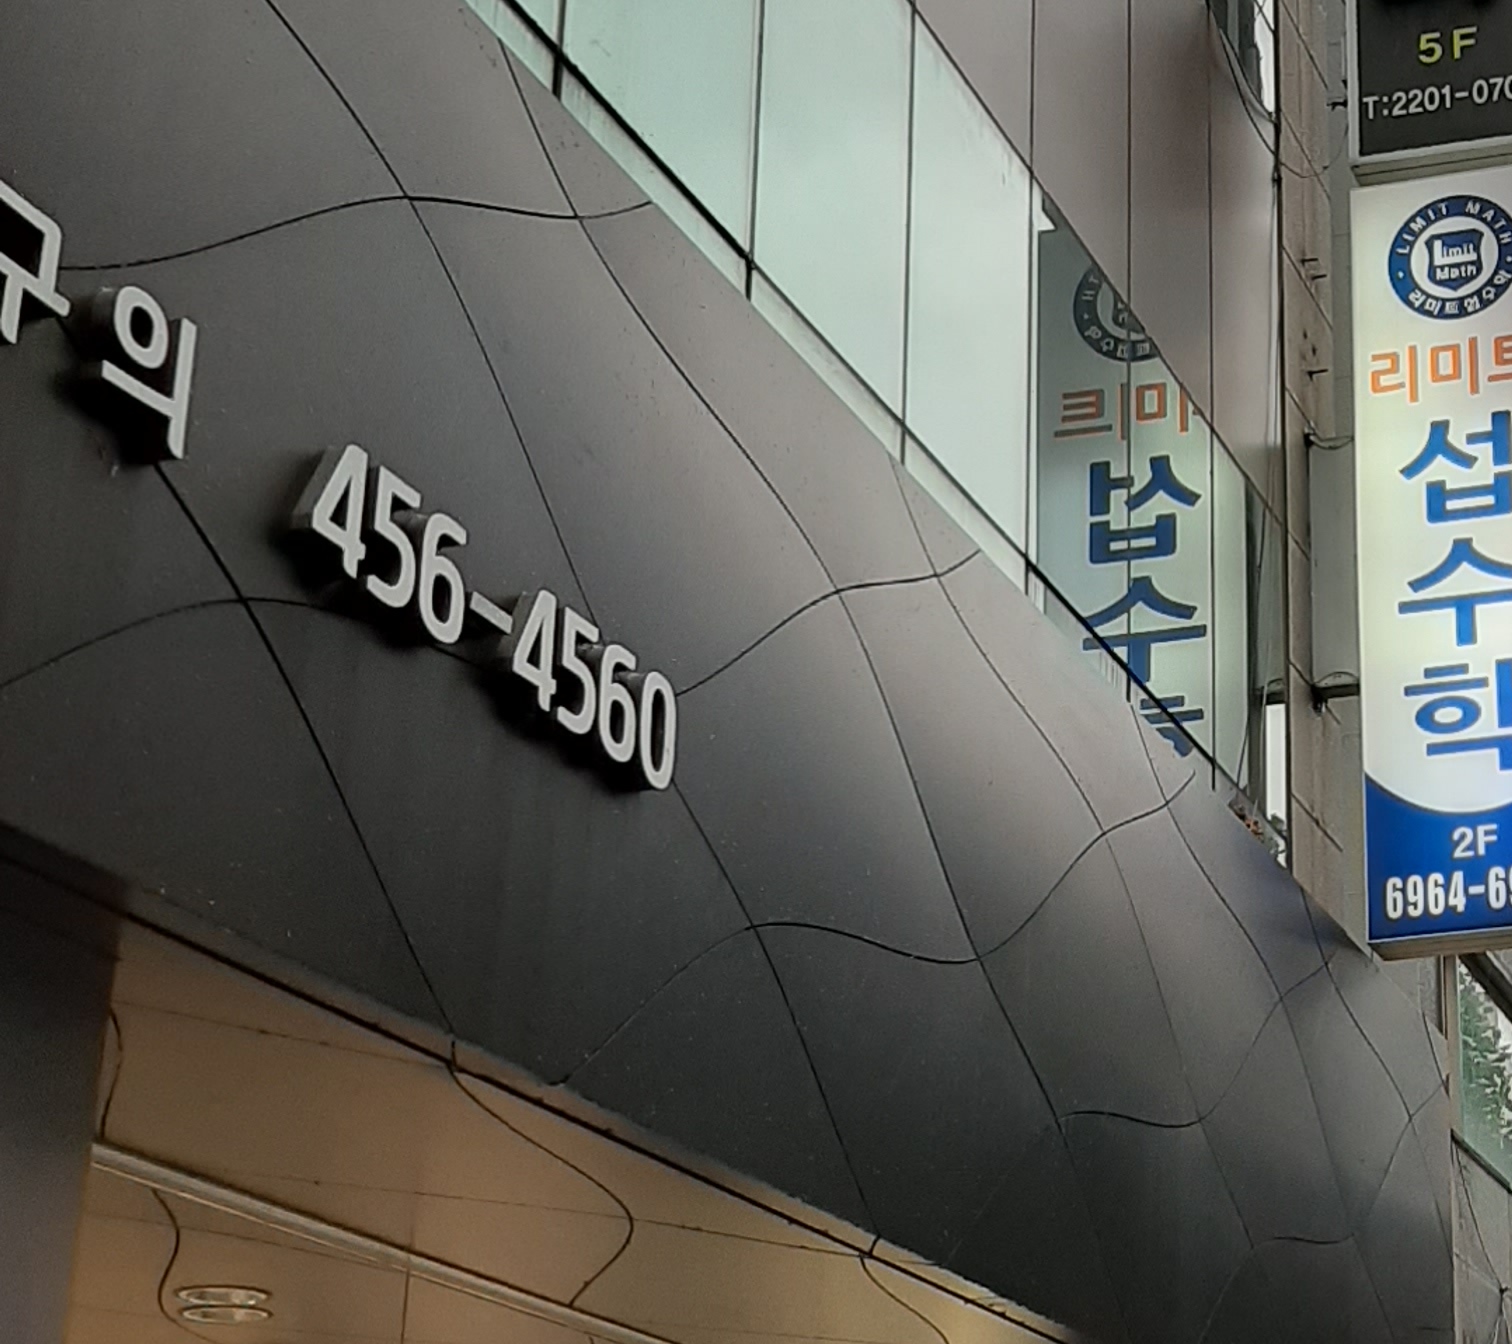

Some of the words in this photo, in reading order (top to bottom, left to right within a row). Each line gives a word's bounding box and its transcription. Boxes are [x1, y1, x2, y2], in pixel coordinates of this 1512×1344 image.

[1417, 26, 1478, 65] 5F
[1396, 202, 1449, 255] LIMIT
[1464, 200, 1512, 244] MATH
[310, 442, 678, 791] 456-4560
[1451, 824, 1499, 858] 2F
